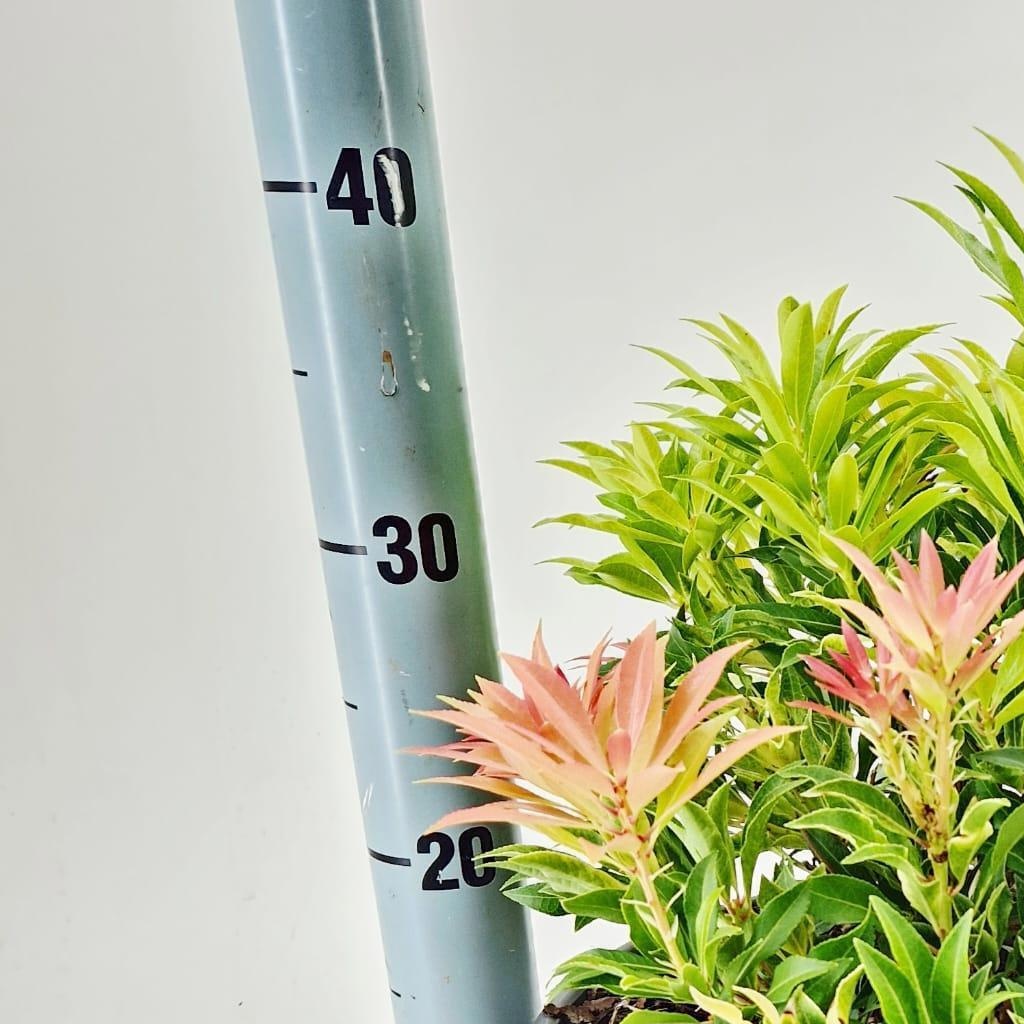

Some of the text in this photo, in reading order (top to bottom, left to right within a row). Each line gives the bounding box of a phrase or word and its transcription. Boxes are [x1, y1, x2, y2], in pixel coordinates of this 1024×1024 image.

[326, 147, 417, 227] 40
[372, 512, 460, 585] 30
[416, 826, 496, 890] 20
